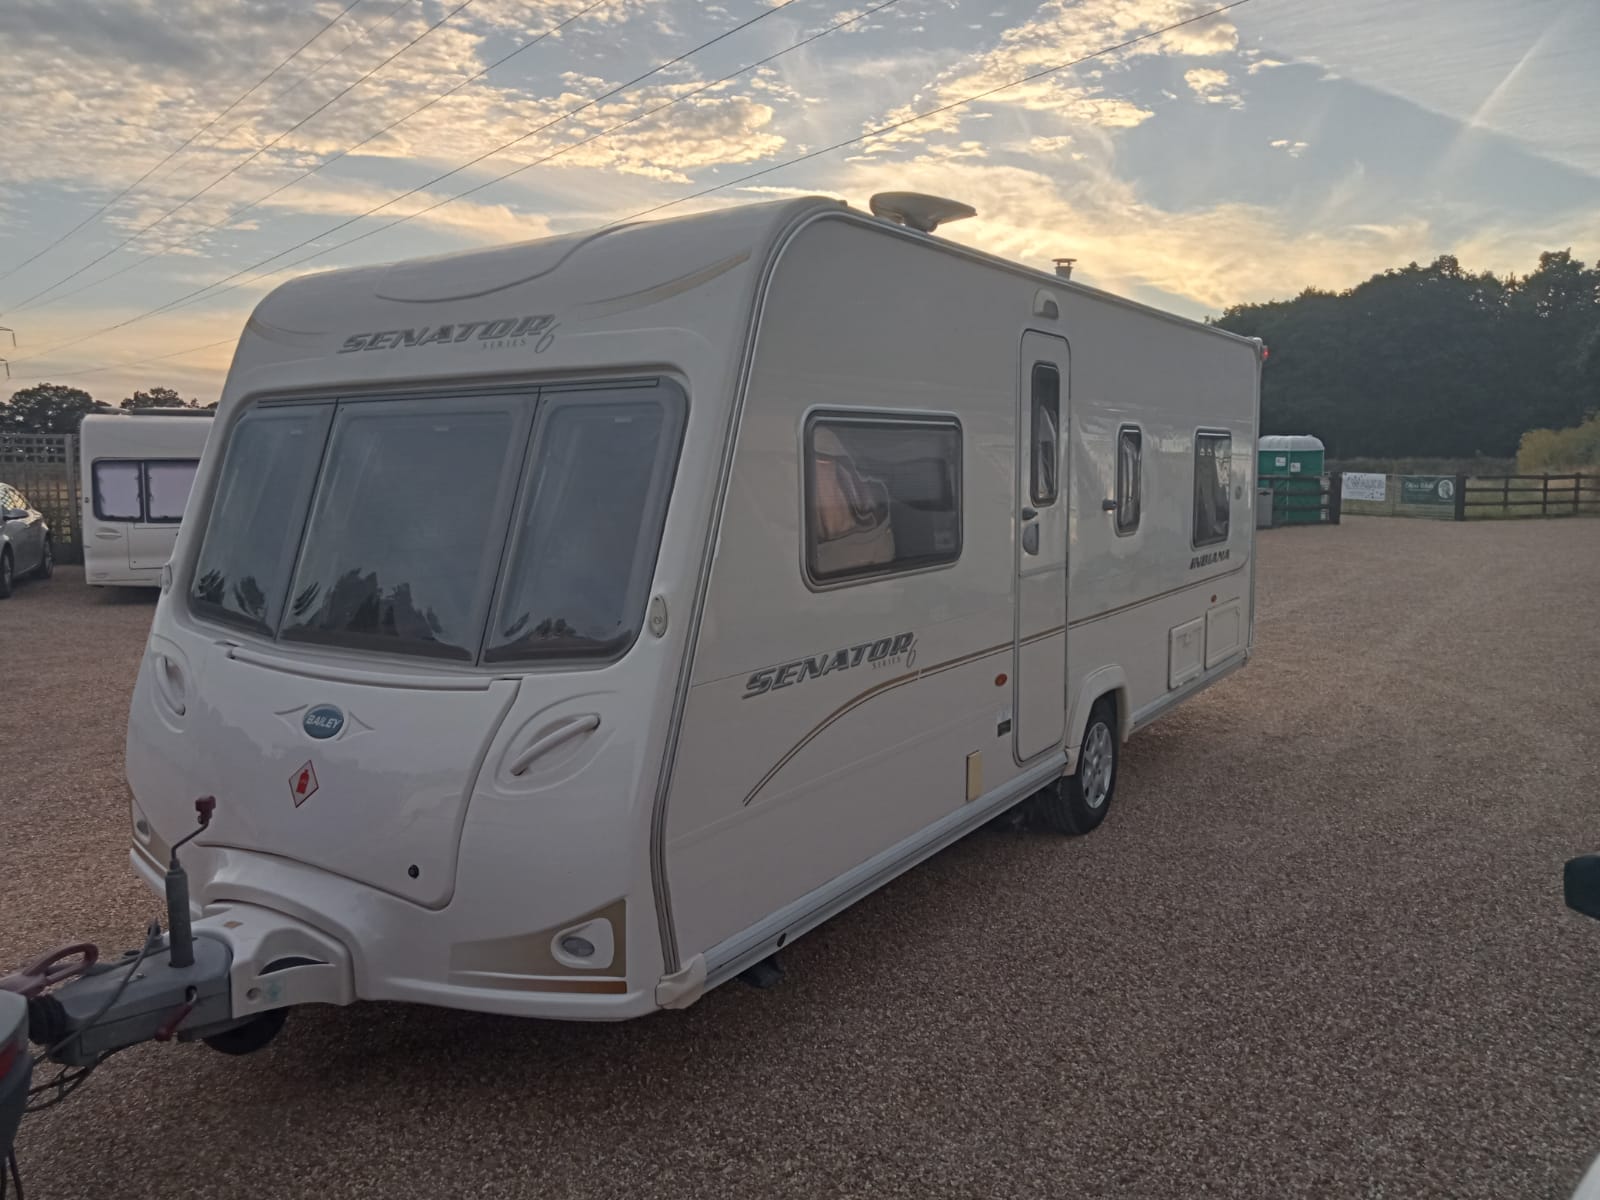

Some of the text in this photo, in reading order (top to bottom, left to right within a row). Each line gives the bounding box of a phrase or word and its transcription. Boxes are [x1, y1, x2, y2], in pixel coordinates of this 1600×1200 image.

[336, 314, 556, 355] SENATOR
[1189, 549, 1230, 570] INDIANA
[742, 631, 914, 700] SENATOR
[306, 714, 341, 729] BAILEY
